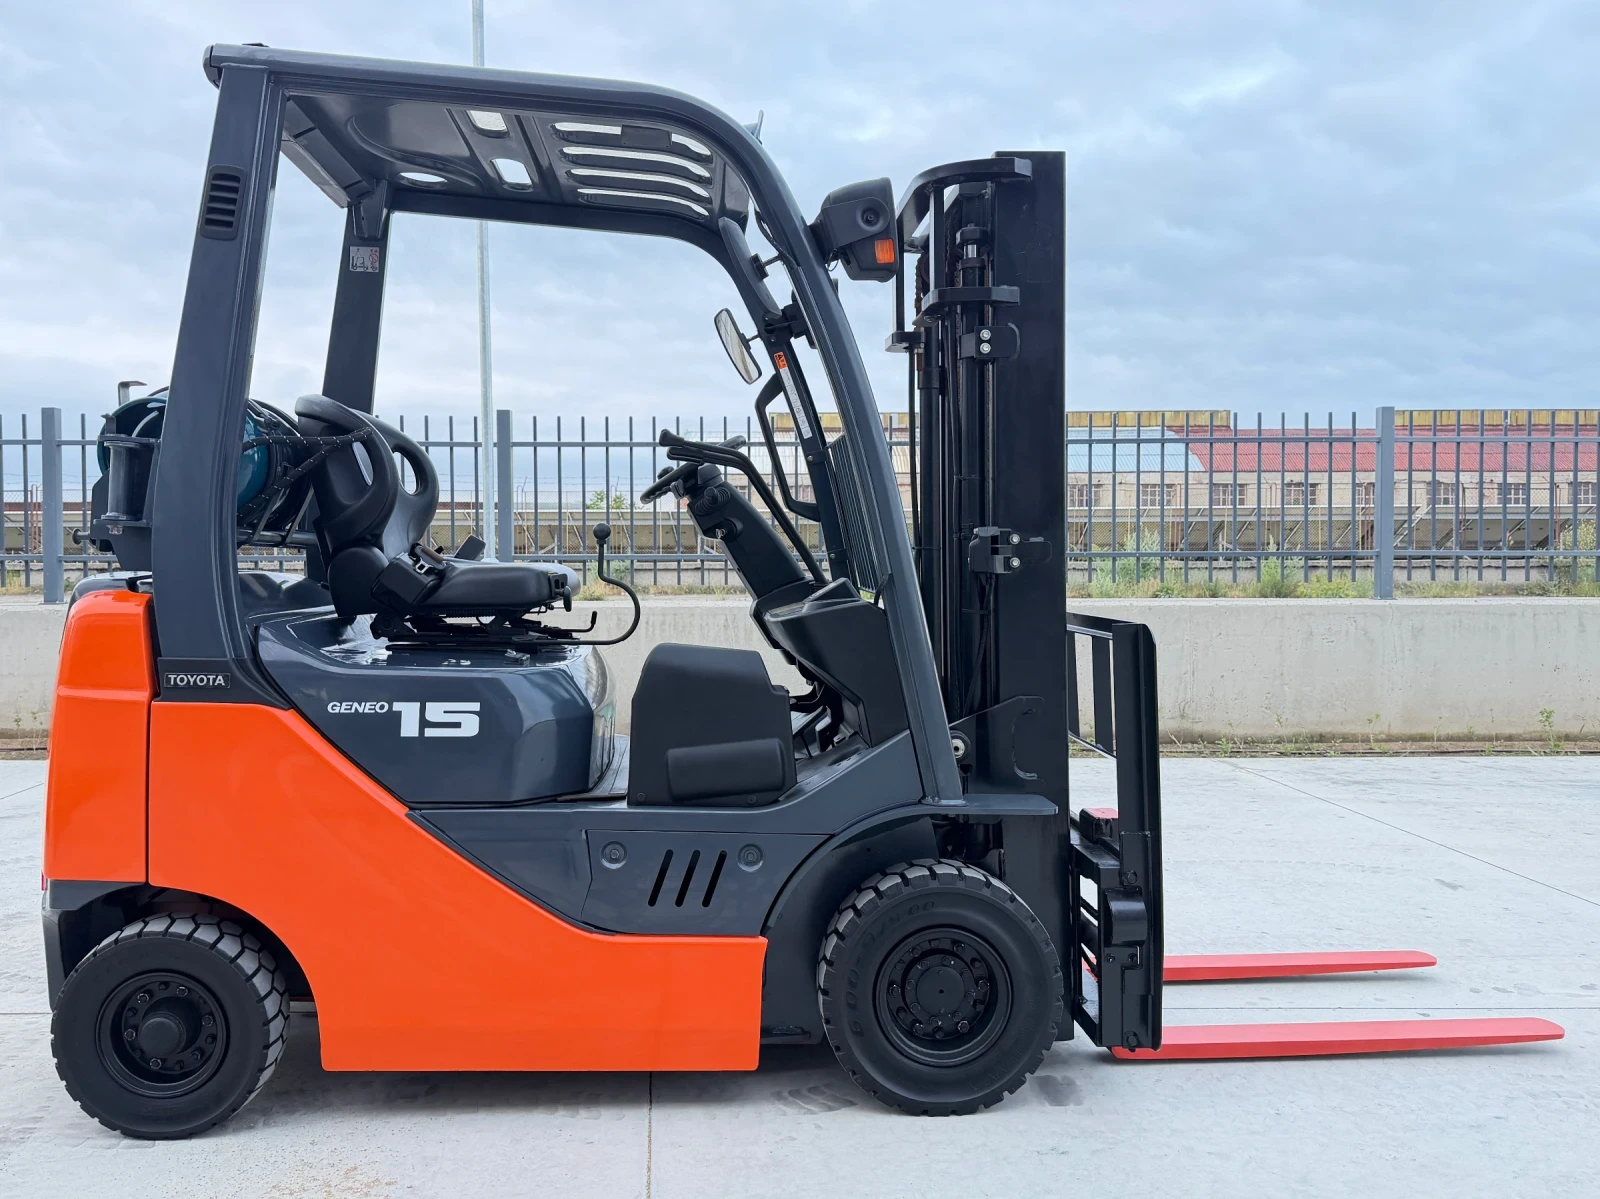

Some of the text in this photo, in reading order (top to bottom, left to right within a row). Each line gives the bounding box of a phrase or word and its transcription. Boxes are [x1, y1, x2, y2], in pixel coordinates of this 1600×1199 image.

[168, 674, 226, 686] TOYOTA
[327, 701, 481, 738] GENEO 15
